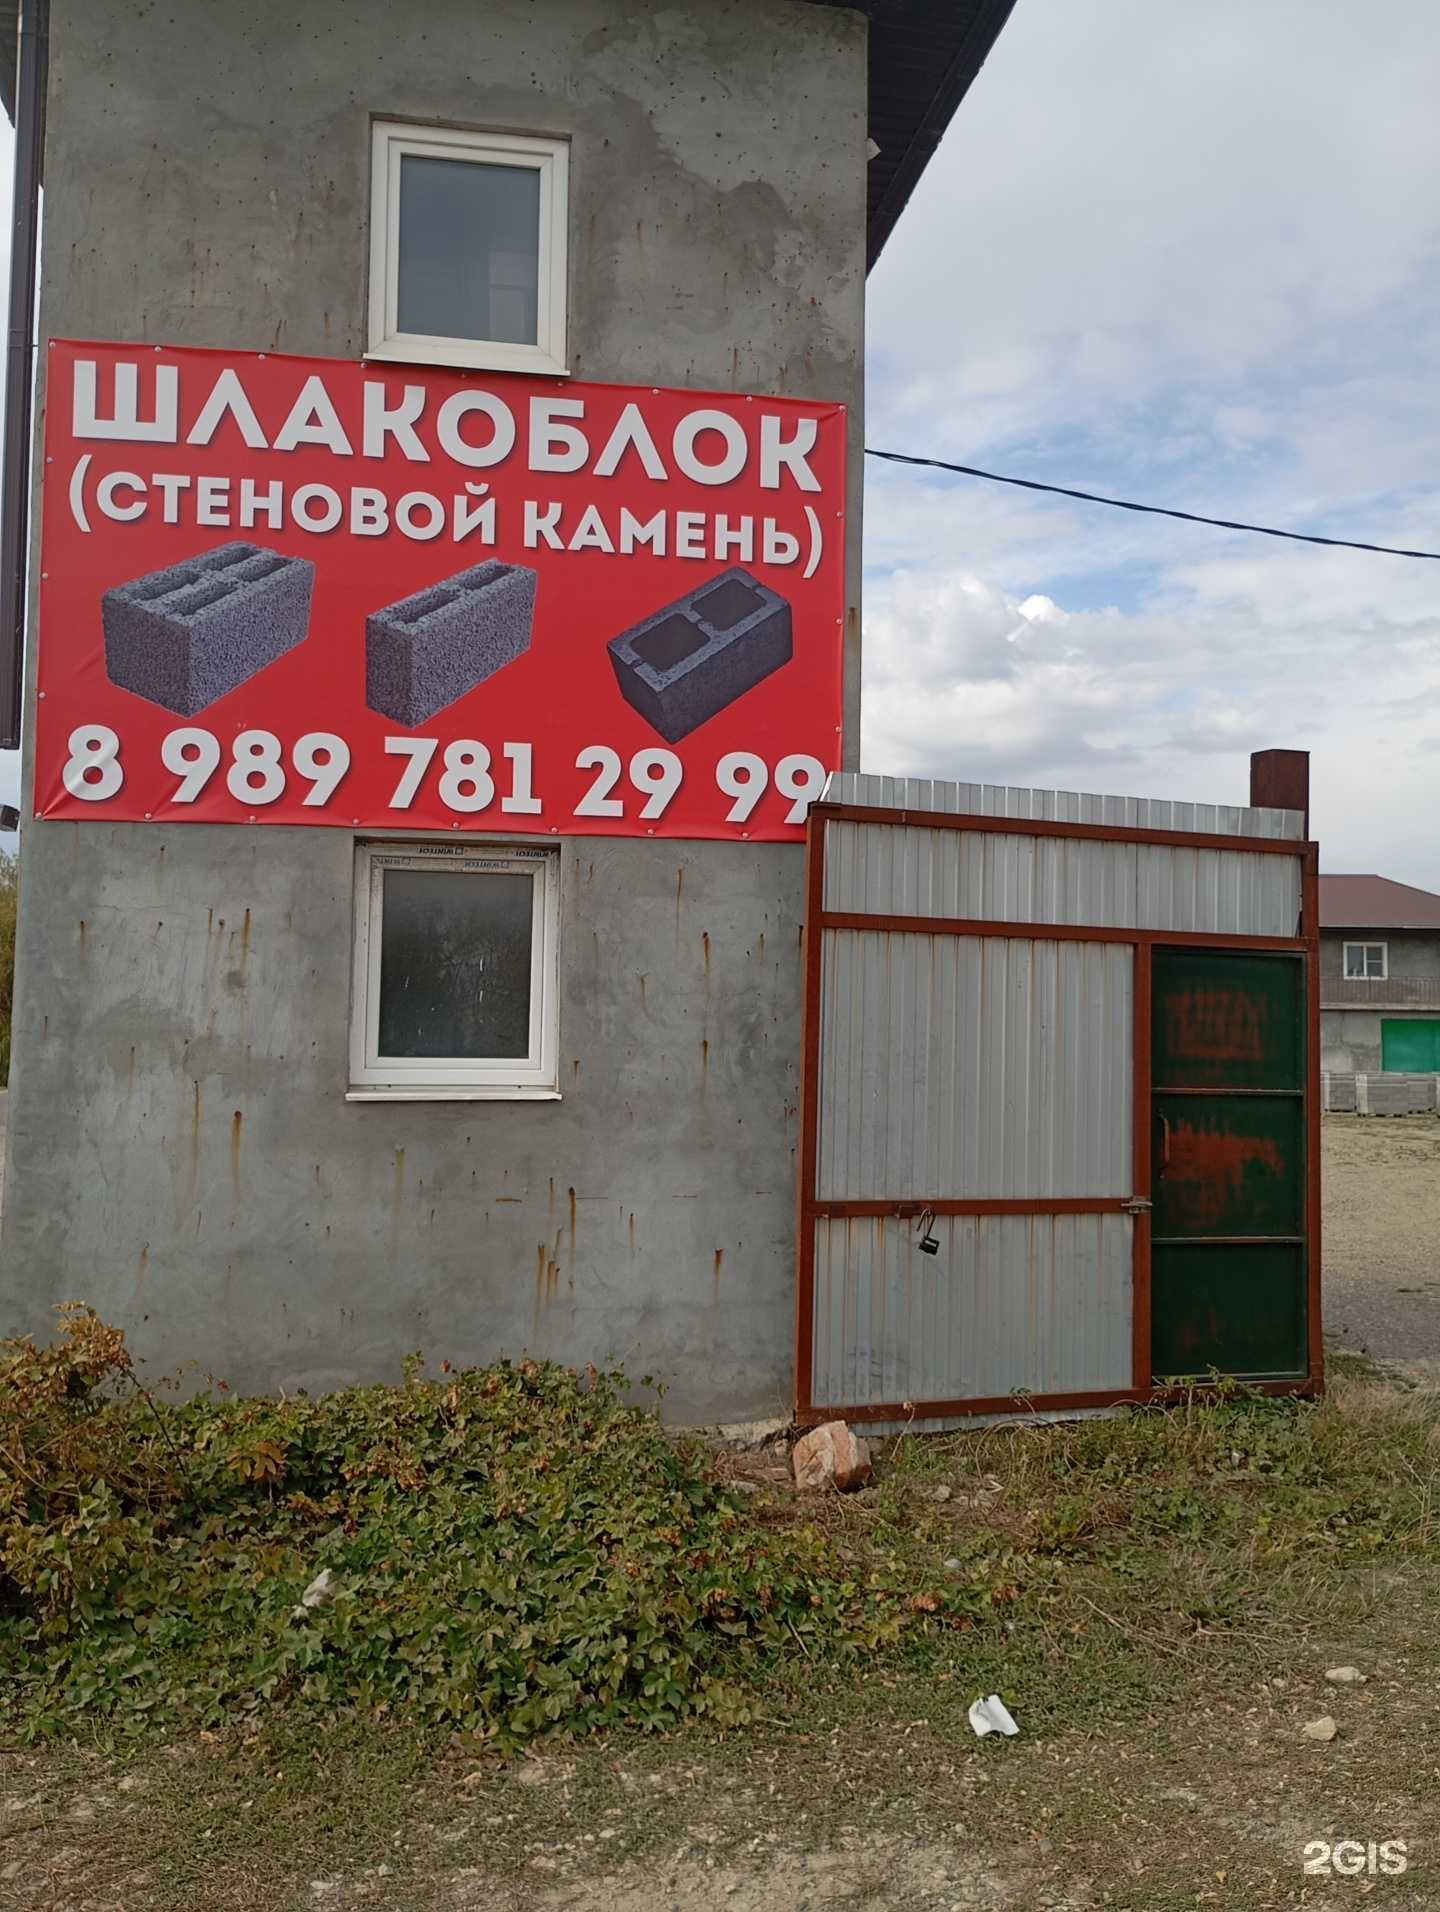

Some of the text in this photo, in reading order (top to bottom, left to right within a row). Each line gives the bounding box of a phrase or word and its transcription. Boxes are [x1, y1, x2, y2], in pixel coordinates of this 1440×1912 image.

[72, 359, 822, 492] ШЛАКОБЛОК
[69, 454, 823, 578] (СТЕНОВОЙ КАМЕНЬ)
[62, 724, 826, 824] 8 989 781 29 99
